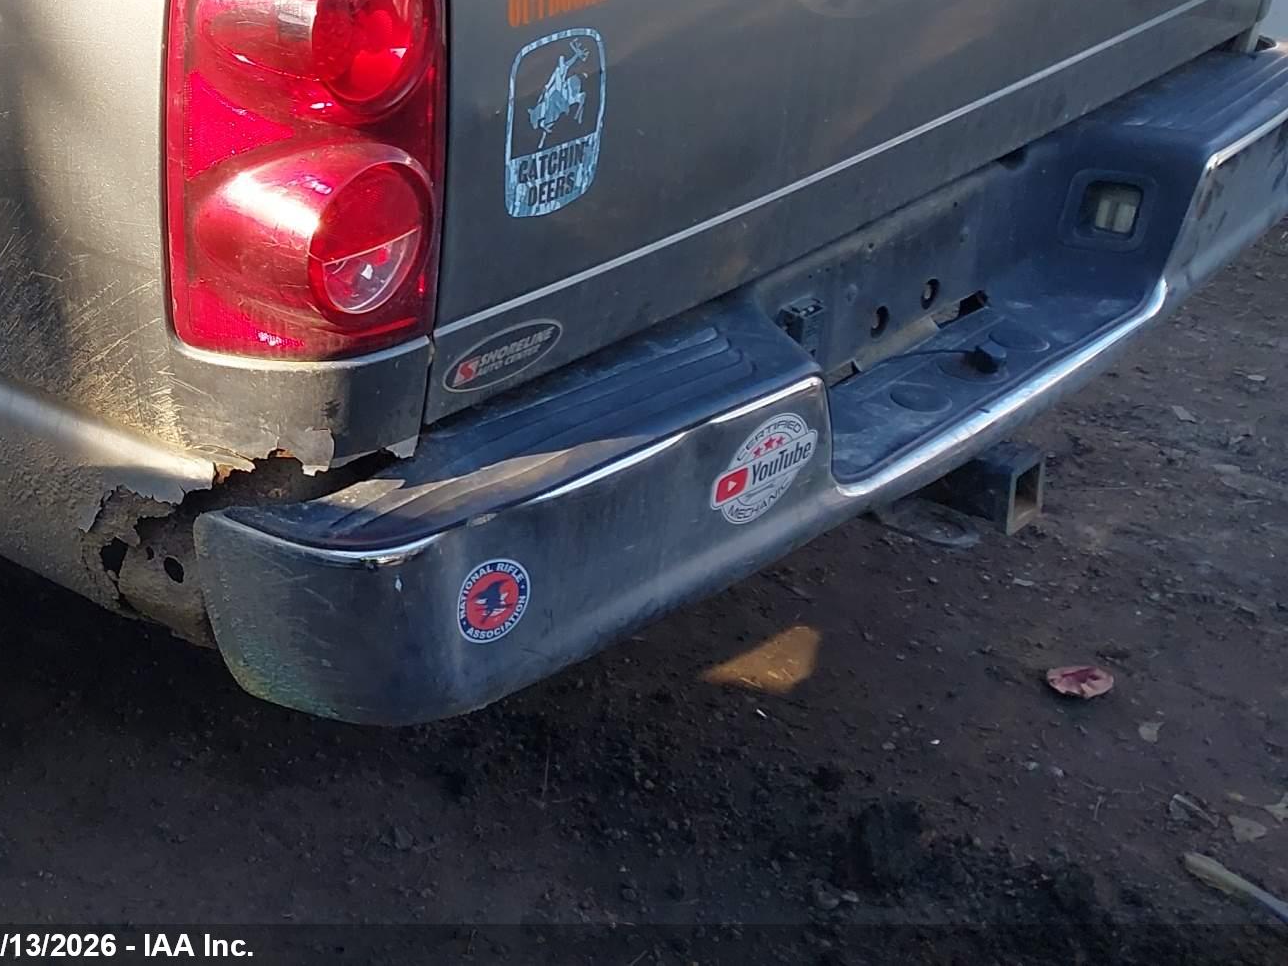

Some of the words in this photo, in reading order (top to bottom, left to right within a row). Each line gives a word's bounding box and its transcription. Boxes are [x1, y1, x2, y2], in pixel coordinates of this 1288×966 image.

[528, 172, 576, 207] DEERS
[736, 420, 802, 462] CERTIFIED
[751, 441, 812, 486] YouTube
[727, 476, 791, 520] MECHANIC
[459, 565, 494, 619] NATIONAL
[496, 562, 526, 583] RIFLE
[466, 595, 527, 639] ASSOCIATION
